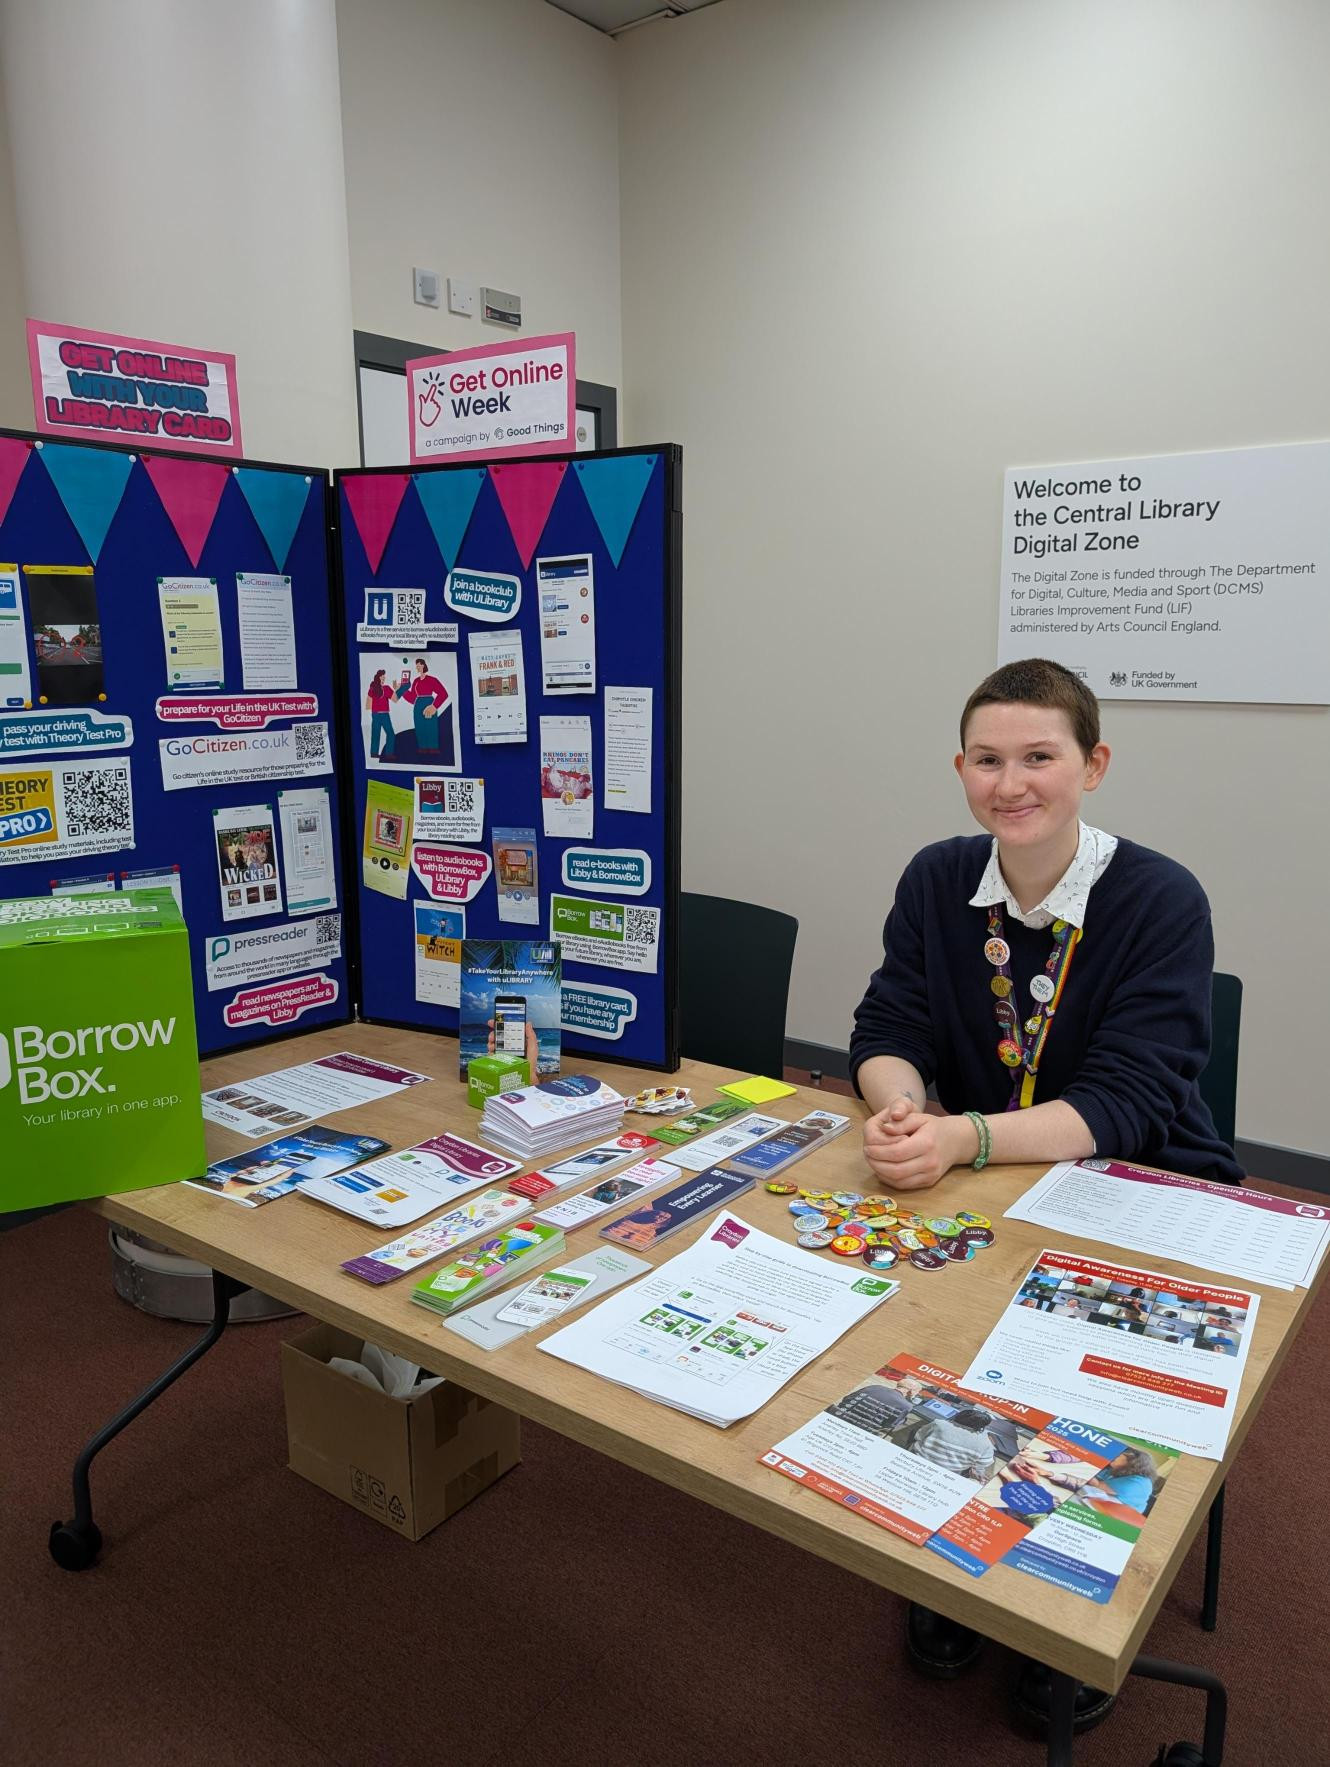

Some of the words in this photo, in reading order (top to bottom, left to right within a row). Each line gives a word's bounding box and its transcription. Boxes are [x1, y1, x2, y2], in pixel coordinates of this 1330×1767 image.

[59, 340, 116, 373] GET
[116, 350, 209, 386] ONLINE
[450, 370, 486, 394] Get
[492, 361, 563, 388] Online
[67, 370, 137, 404] WITH
[138, 380, 208, 413] YOUR
[452, 392, 511, 418] Week
[46, 396, 162, 434] LIBRARY
[162, 411, 231, 441] CARD
[433, 434, 477, 448] campaign
[479, 430, 490, 443] by
[507, 426, 531, 437] Good
[534, 422, 564, 435] Things
[1014, 476, 1112, 499] Welcome
[1119, 474, 1141, 492] to
[1014, 509, 1047, 527] the
[1054, 502, 1131, 525] Central
[1140, 499, 1220, 521] Library
[1014, 533, 1077, 558] Digital
[1084, 532, 1139, 551] Zone
[1012, 572, 1030, 583] The
[1034, 570, 1067, 584] Digital
[1070, 570, 1098, 581] Zone
[1102, 570, 1110, 580] is
[1114, 567, 1155, 580] funded
[1159, 566, 1205, 580] through
[1210, 565, 1233, 577] The
[1237, 562, 1316, 579] Department
[162, 582, 210, 590] GoCitizen.co.uk
[452, 578, 468, 590] join
[476, 582, 513, 596] bookclub
[1011, 589, 1026, 600] for
[1029, 587, 1063, 602] Digital,
[1067, 586, 1110, 600] Culture,
[1113, 585, 1148, 598] Media
[1151, 584, 1173, 597] and
[1176, 584, 1210, 599] Sport
[1214, 582, 1264, 597] (DCMS)
[456, 591, 472, 602] with
[474, 594, 509, 610] ULibrary
[1011, 605, 1054, 616] Libraries
[1057, 603, 1131, 618] Improvement
[1134, 603, 1163, 615] Fund
[1167, 601, 1192, 616] (LIF)
[1010, 621, 1078, 633] administered
[1081, 621, 1095, 635] by
[1097, 621, 1120, 632] Arts
[1123, 620, 1167, 632] Council
[1171, 620, 1222, 634] England.
[480, 661, 497, 670] FRANK
[504, 659, 514, 667] RED
[1146, 680, 1197, 688] Government
[1165, 671, 1175, 680] by
[164, 705, 198, 716] prepare
[199, 703, 211, 713] for
[211, 703, 230, 714] your
[231, 702, 246, 712] Life
[246, 702, 254, 712] in
[254, 702, 268, 712] the
[269, 702, 280, 711] UK
[282, 702, 297, 711] Test
[297, 701, 312, 710] with
[3, 726, 27, 736] pass
[28, 724, 52, 734] your
[53, 720, 86, 732] driving
[223, 714, 261, 723] GoCitizen
[4, 736, 27, 745] test
[28, 734, 49, 744] with
[50, 732, 85, 744] Theory
[86, 730, 104, 740] Test
[106, 729, 121, 738] Pro
[166, 733, 289, 755] GoCitizen.co.uk
[422, 784, 442, 793] Libby
[0, 815, 36, 837] PRO
[417, 852, 435, 861] listen
[444, 856, 483, 867] audiobooks
[573, 859, 589, 867] read
[591, 860, 620, 870] e-books
[621, 862, 638, 871] with
[423, 863, 437, 871] with
[438, 864, 477, 877] BorrowBox,
[571, 869, 591, 880] Libby
[592, 870, 598, 878] &
[599, 871, 641, 882] BorrowBox
[436, 874, 465, 886] ULibrary
[437, 883, 442, 891] &
[443, 885, 462, 895] Libby
[234, 927, 308, 952] pressreader
[427, 944, 455, 957] WITCH
[468, 968, 553, 976] #TakeYourLibraryAnywhere
[231, 1004, 270, 1019] magazines
[271, 1001, 280, 1009] on
[282, 991, 324, 1006] PressReader
[326, 988, 331, 996] &
[242, 994, 259, 1006] read
[261, 986, 305, 1002] newspapers
[306, 982, 319, 991] and
[569, 994, 586, 1003] FREE
[587, 997, 610, 1009] library
[611, 1002, 628, 1013] card,
[273, 1008, 293, 1019] Libby
[569, 1004, 583, 1012] you
[584, 1006, 601, 1015] have
[602, 1010, 615, 1020] any
[13, 1017, 177, 1064] Borrow
[17, 1067, 116, 1105] Box.
[22, 1113, 56, 1127] Your
[60, 1106, 102, 1126] library
[107, 1102, 118, 1114] in
[123, 1098, 148, 1112] one
[152, 1095, 182, 1112] app.
[1128, 1167, 1162, 1178] Croydon
[1163, 1174, 1200, 1186] Libraries
[1208, 1184, 1244, 1196] Opening
[1245, 1192, 1272, 1201] Hours
[668, 1182, 714, 1207] Empowering
[719, 1230, 740, 1243] Libraries
[722, 1226, 743, 1240] Croydon
[1083, 1263, 1143, 1281] Awareness
[1147, 1276, 1167, 1286] For
[1169, 1282, 1200, 1294] Older
[918, 1364, 962, 1388] DIGITA
[976, 1376, 1005, 1386] zoom
[1047, 1424, 1069, 1436] 2025
[1128, 1426, 1208, 1450] clearcommunityweb
[860, 1505, 921, 1539] clearcommunityweb
[1017, 1562, 1093, 1598] clearcommunityweb
